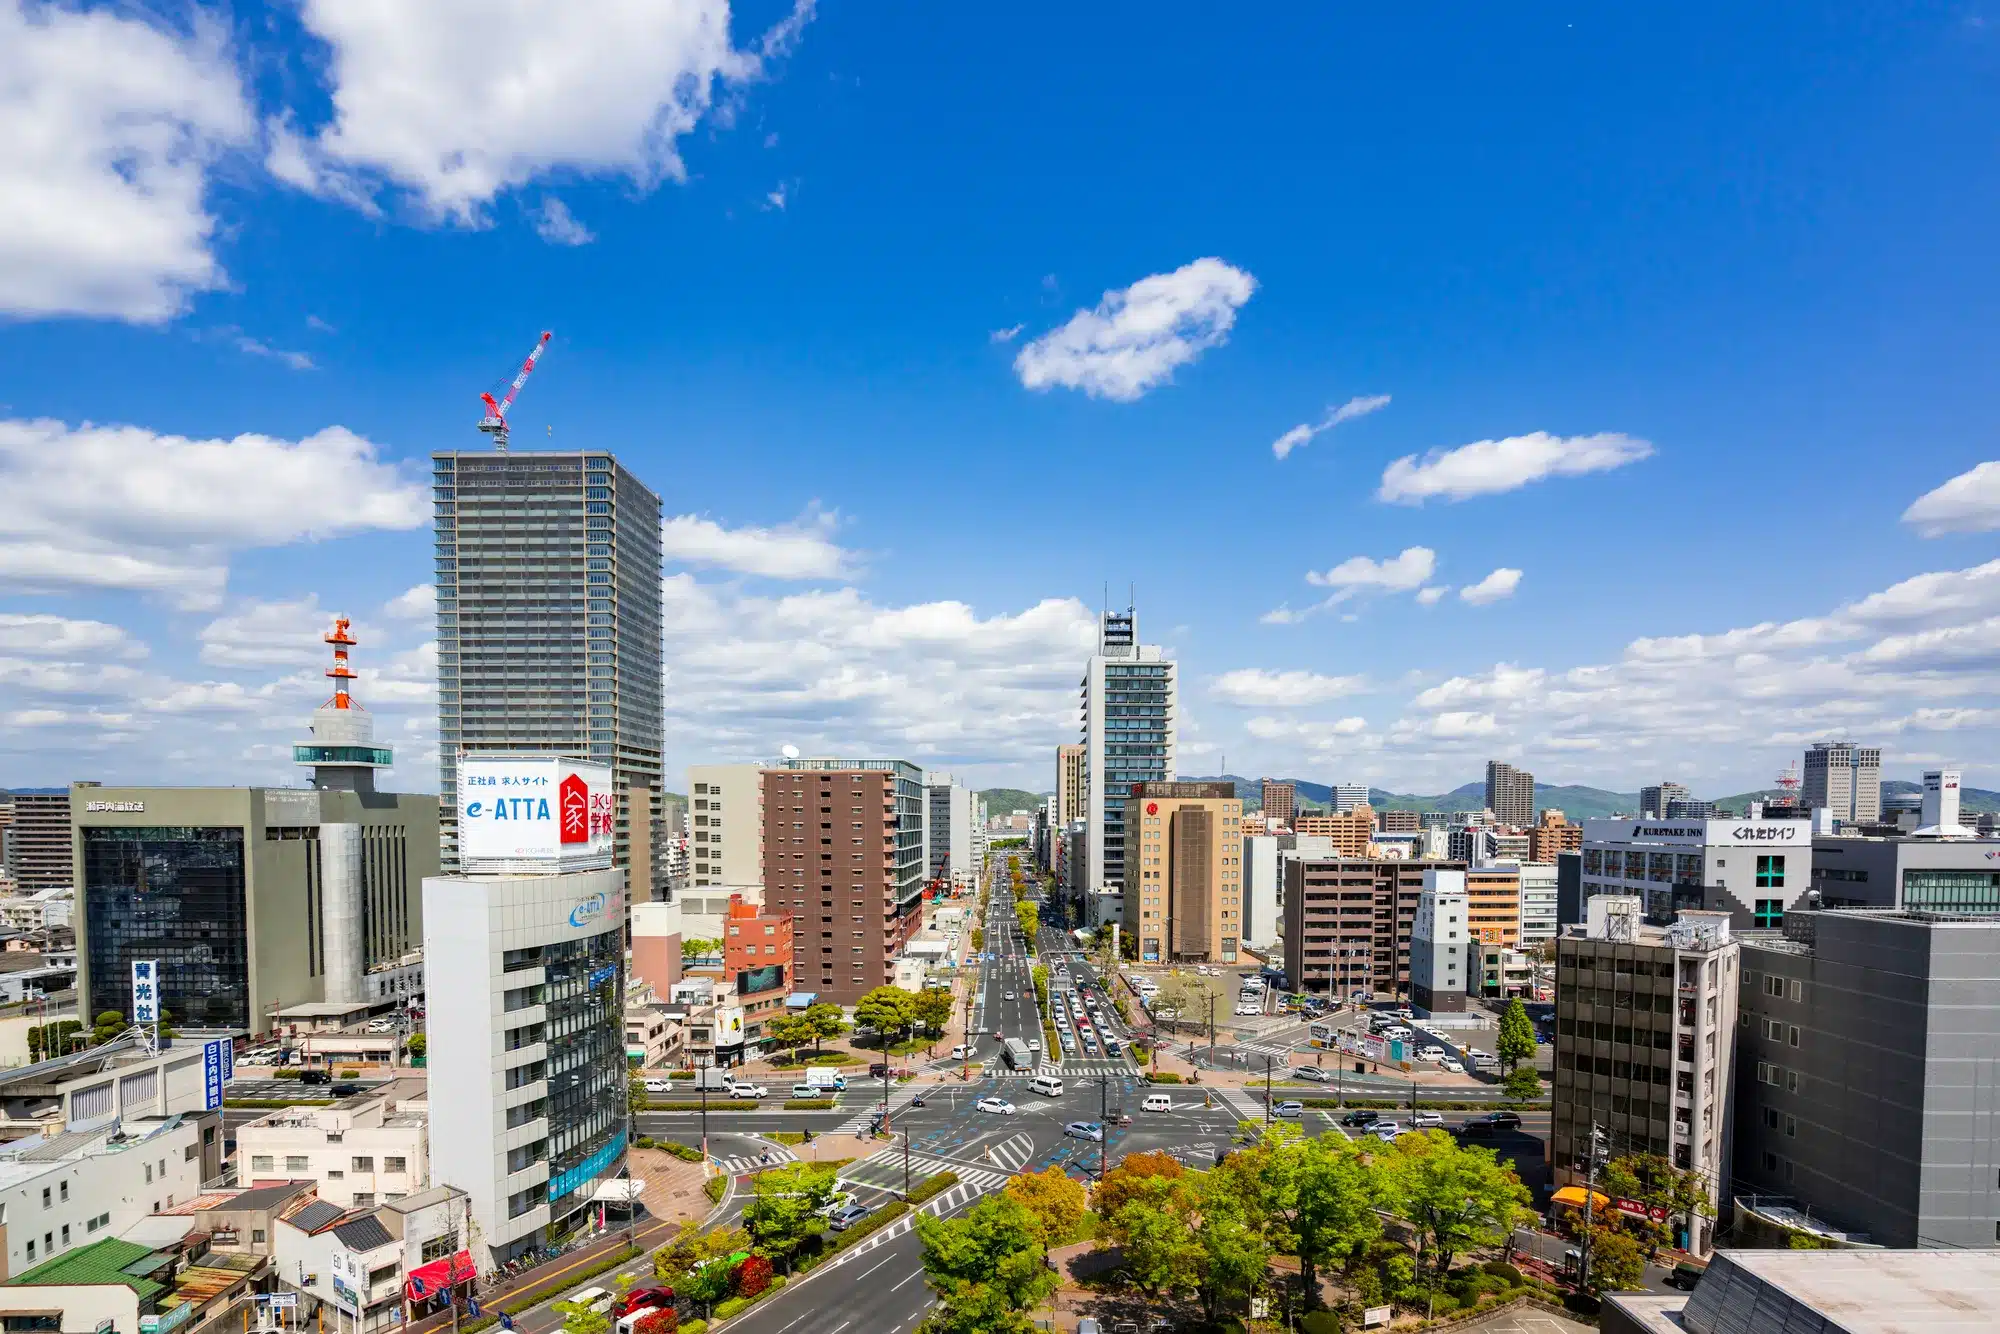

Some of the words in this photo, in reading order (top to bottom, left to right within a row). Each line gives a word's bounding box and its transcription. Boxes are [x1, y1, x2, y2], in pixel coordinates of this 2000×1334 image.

[467, 776, 496, 786] 正社員
[501, 776, 549, 786] 求人サイト
[466, 798, 551, 821] e-ATTA
[590, 793, 612, 810] づくり
[590, 812, 612, 835] 学校
[1643, 827, 1685, 837] KURETAKE
[1687, 828, 1703, 837] INN
[1732, 827, 1796, 840] くれたけイン
[135, 962, 153, 1023] 青光社
